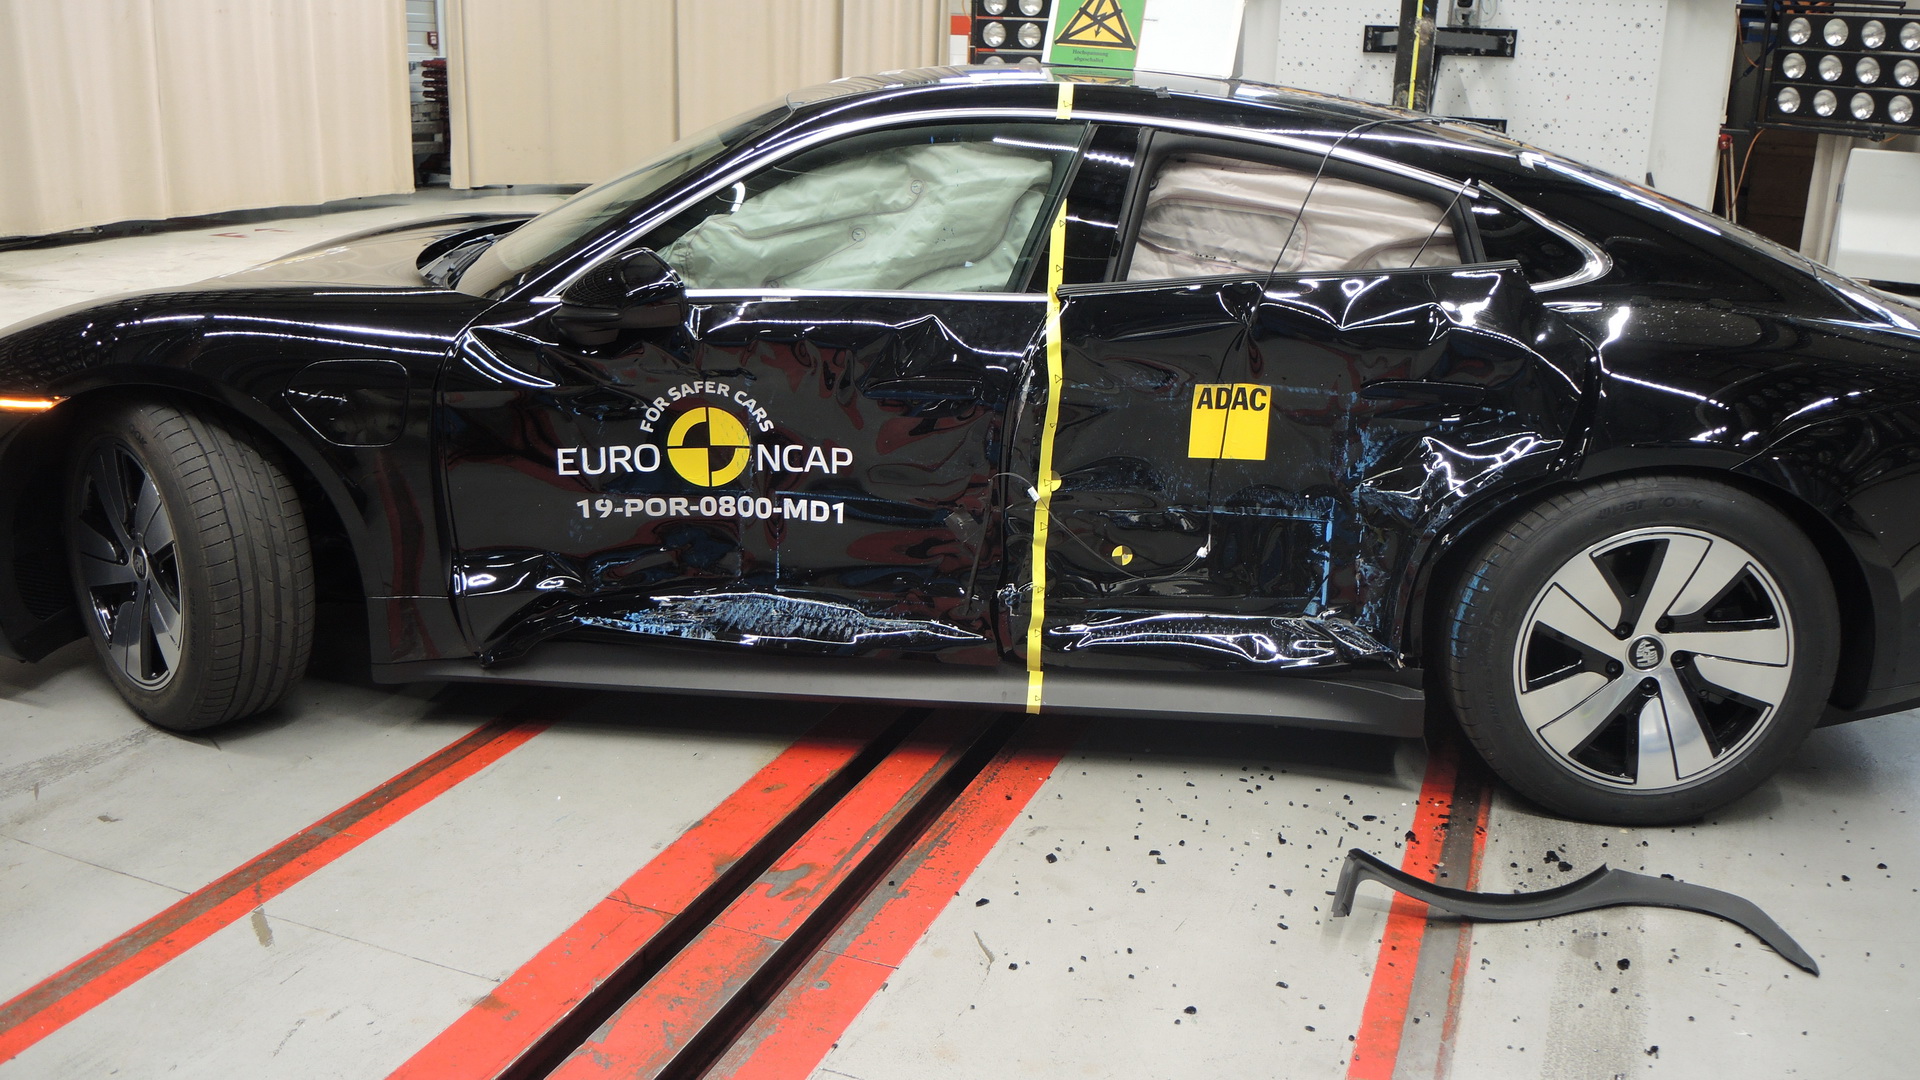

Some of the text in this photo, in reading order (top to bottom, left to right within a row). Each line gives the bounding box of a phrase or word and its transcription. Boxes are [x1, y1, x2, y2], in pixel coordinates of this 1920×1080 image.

[640, 381, 775, 433] FOR SAFER CARS
[1196, 387, 1267, 411] ADAC
[557, 444, 853, 475] EURO NCAP
[576, 496, 844, 523] 19-POR-0800-MD1
